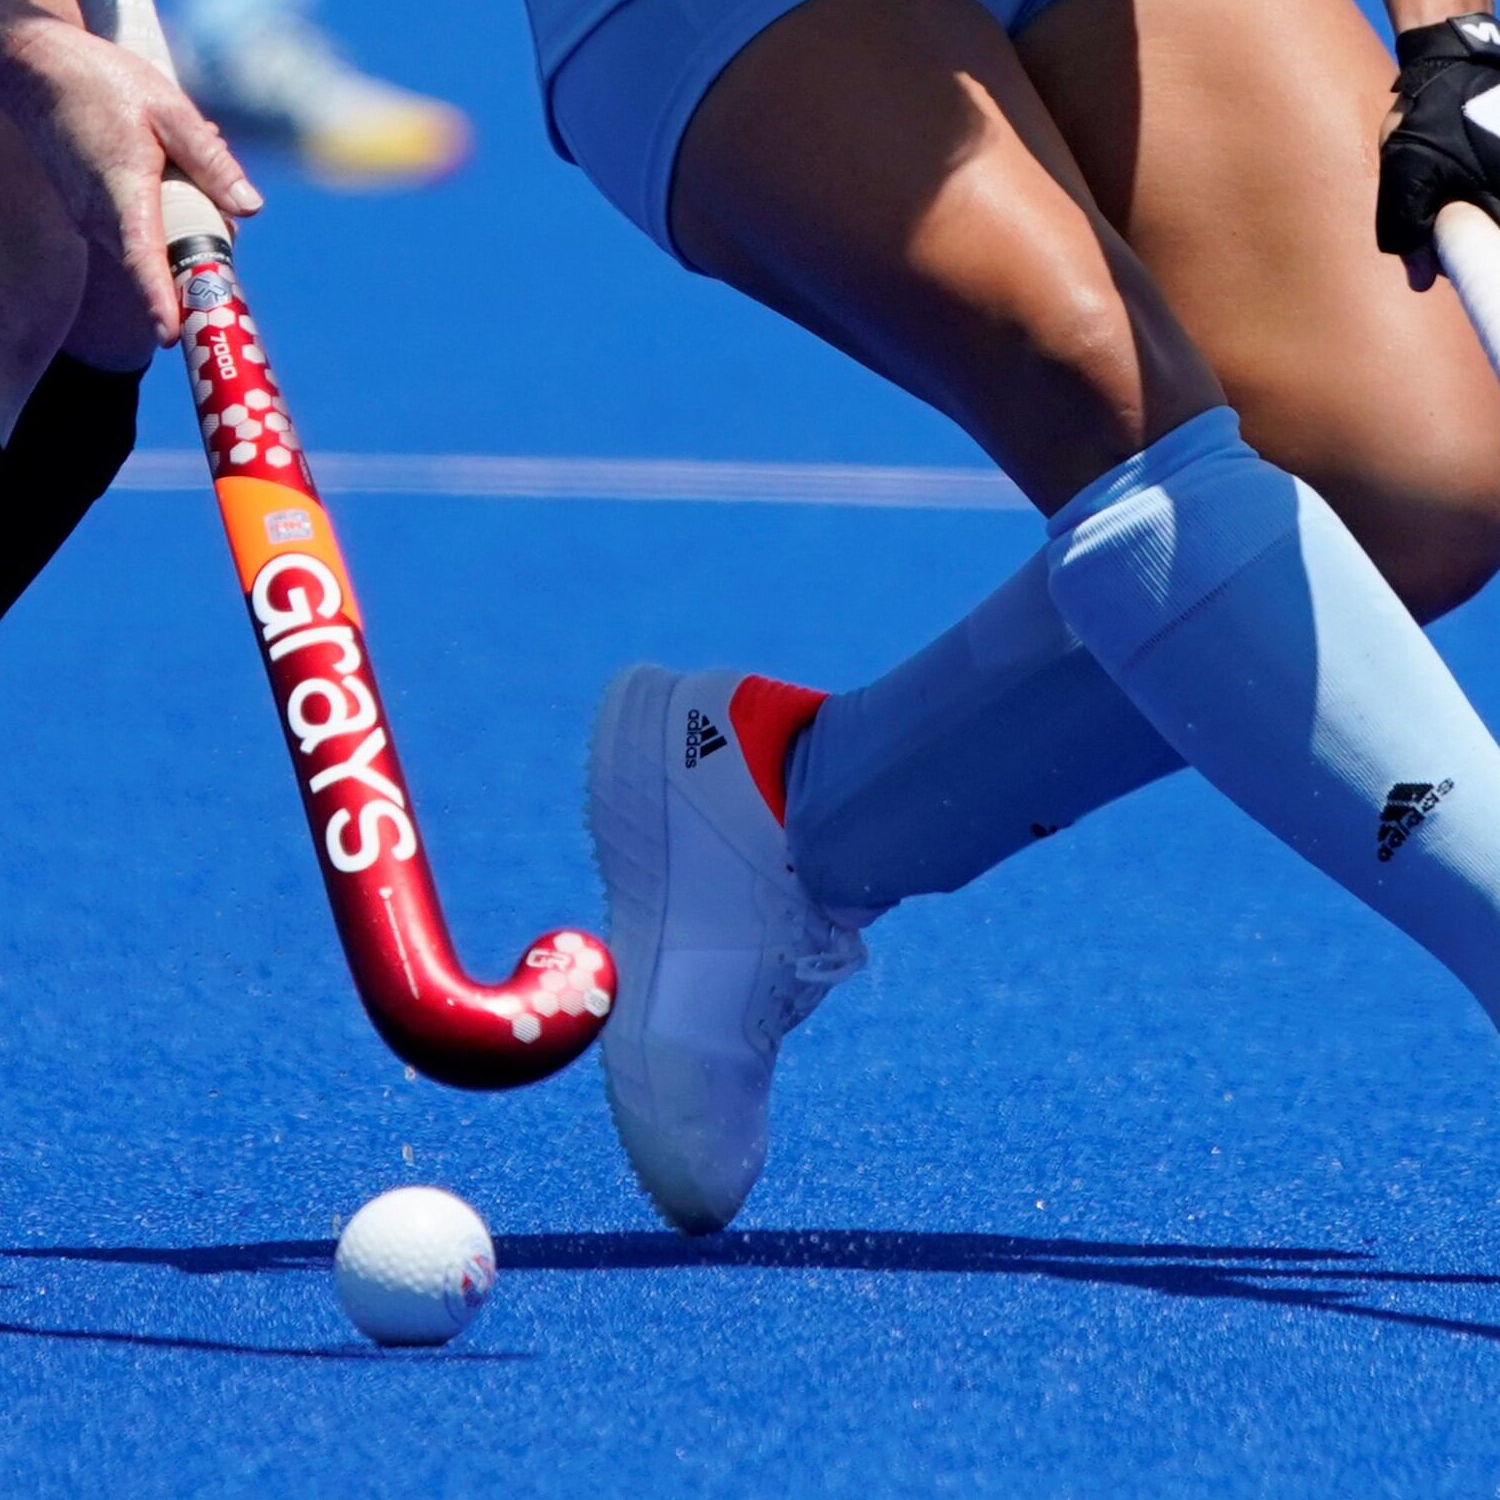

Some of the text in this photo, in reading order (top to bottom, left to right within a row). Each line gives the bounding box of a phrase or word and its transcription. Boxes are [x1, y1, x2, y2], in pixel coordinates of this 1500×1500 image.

[209, 330, 238, 381] 7000
[685, 709, 702, 769] adidas
[1377, 778, 1455, 862] adidas
